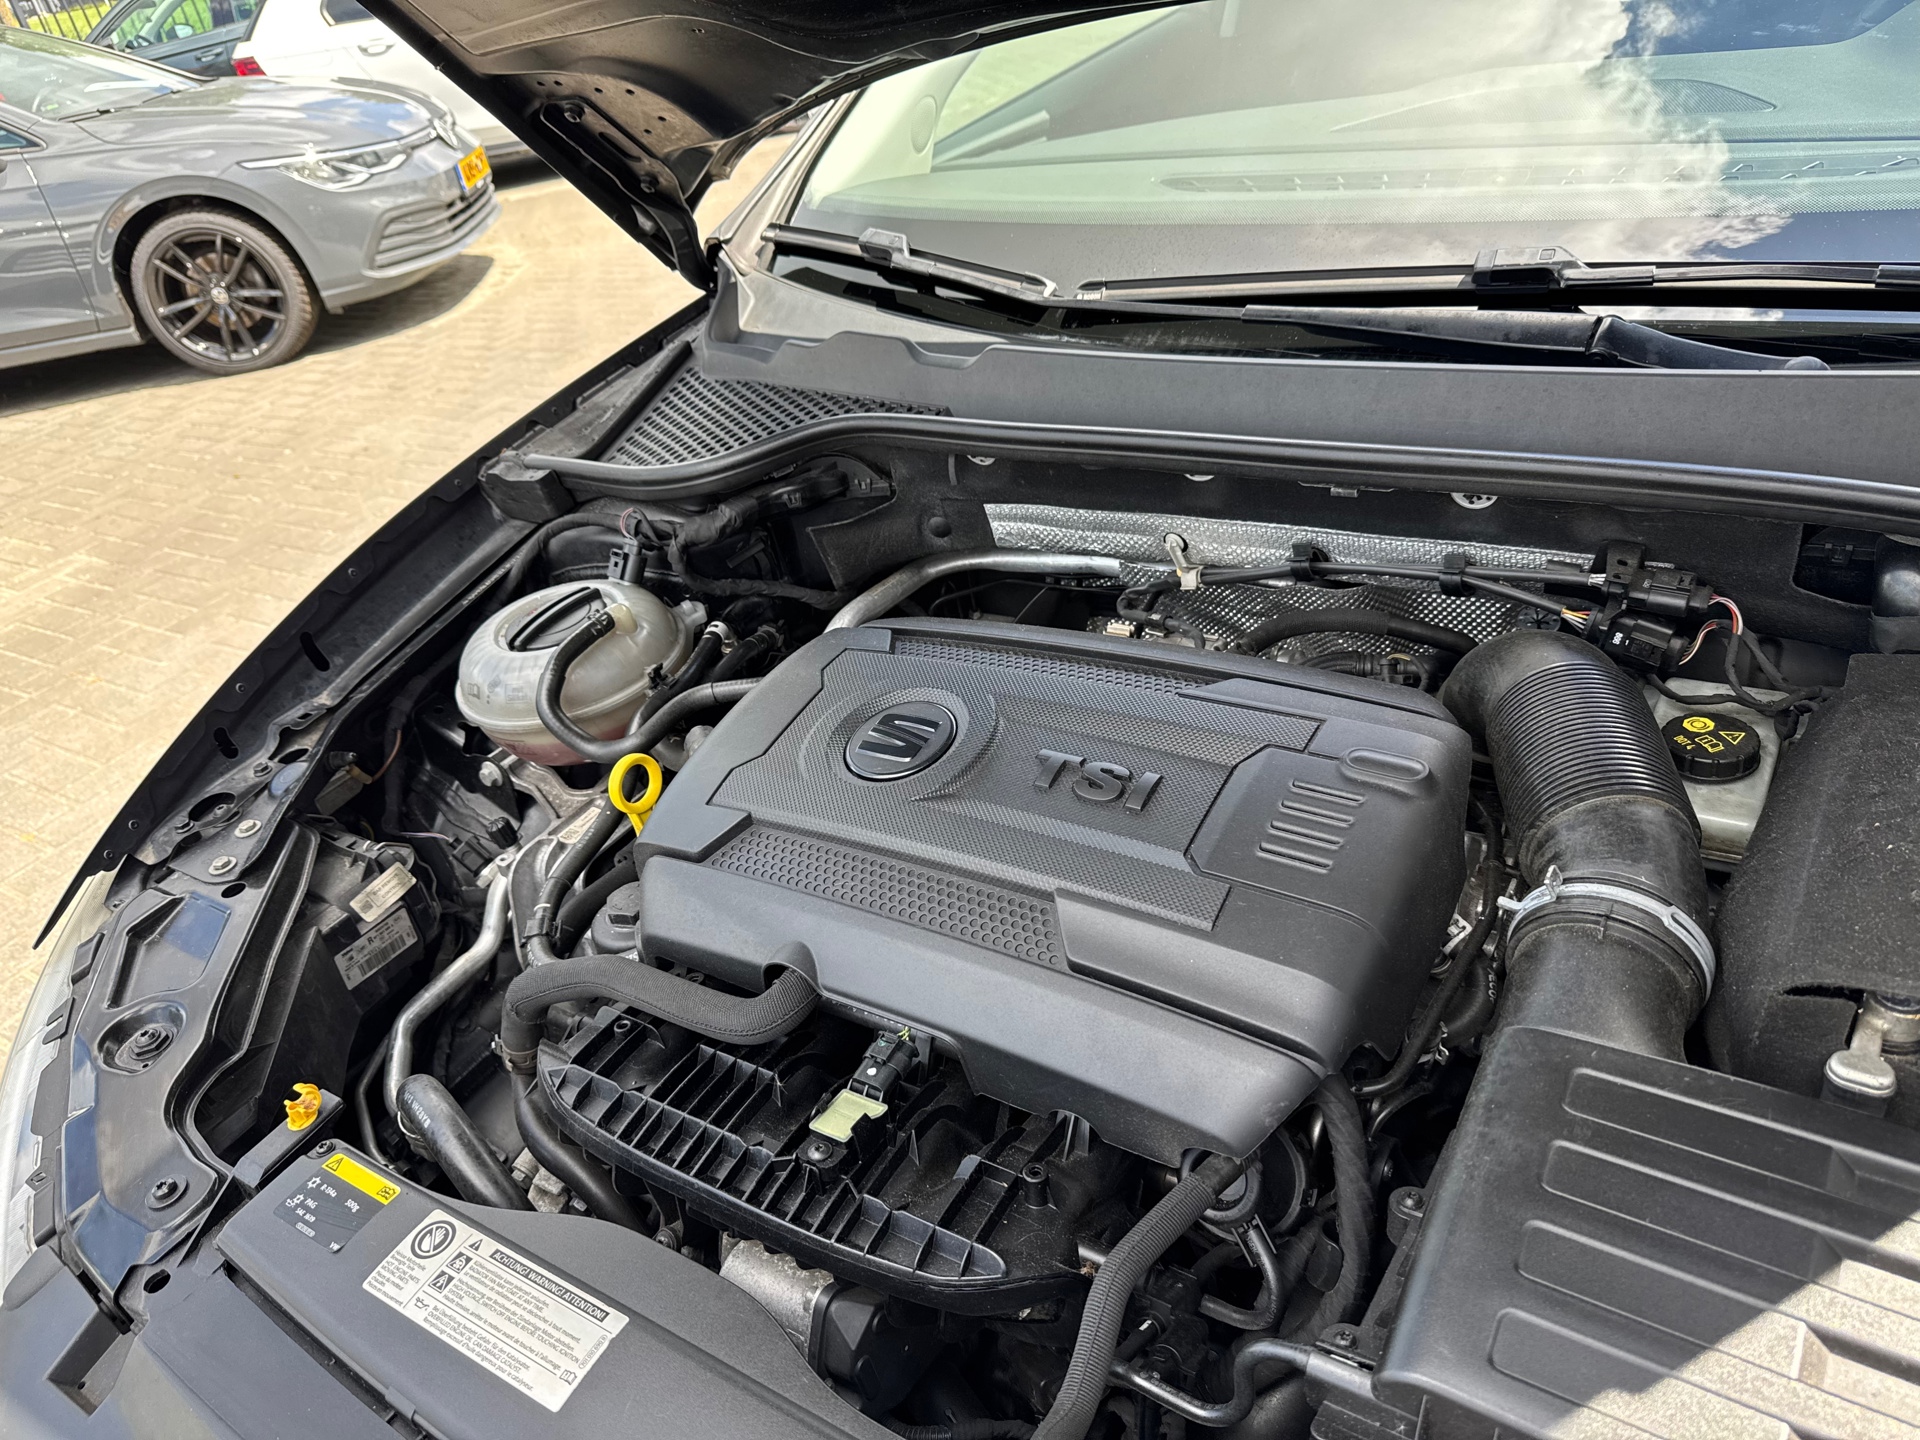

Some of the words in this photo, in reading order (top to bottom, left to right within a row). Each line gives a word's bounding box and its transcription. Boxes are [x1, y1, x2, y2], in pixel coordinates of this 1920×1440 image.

[1034, 749, 1163, 812] TSI
[381, 1264, 397, 1277] MOVING
[396, 1274, 409, 1284] PARTS
[393, 1265, 409, 1276] ENGINE
[408, 1274, 420, 1284] PARTS
[469, 1265, 489, 1279] RADIATOR
[505, 1287, 519, 1297] START
[493, 1252, 530, 1276] ACHTUNG!
[528, 1271, 565, 1296] WARNING!
[562, 1292, 606, 1320] ATTENTION!
[452, 1283, 464, 1292] HIGH
[481, 1300, 497, 1313] SWITCH
[504, 1315, 521, 1328] ENGINE
[520, 1324, 537, 1337] BEFORE
[536, 1334, 560, 1351] TOUCHING
[559, 1348, 580, 1364] IGNITION
[469, 1274, 490, 1288] ventilateur
[494, 1289, 513, 1302] radiateur
[511, 1300, 523, 1308] peut
[552, 1323, 562, 1332] tout
[428, 1311, 451, 1328] OVERFILLED
[449, 1325, 466, 1338] ENGINE
[481, 1345, 502, 1361] DAMAGE
[443, 1294, 455, 1304] Haute
[487, 1322, 503, 1333] moteur
[501, 1331, 515, 1341] avant
[519, 1341, 536, 1354] toucher
[462, 1324, 478, 1337] besteht
[477, 1334, 491, 1345] Gefahr
[541, 1328, 555, 1339] Motor
[495, 1365, 507, 1374] pour
